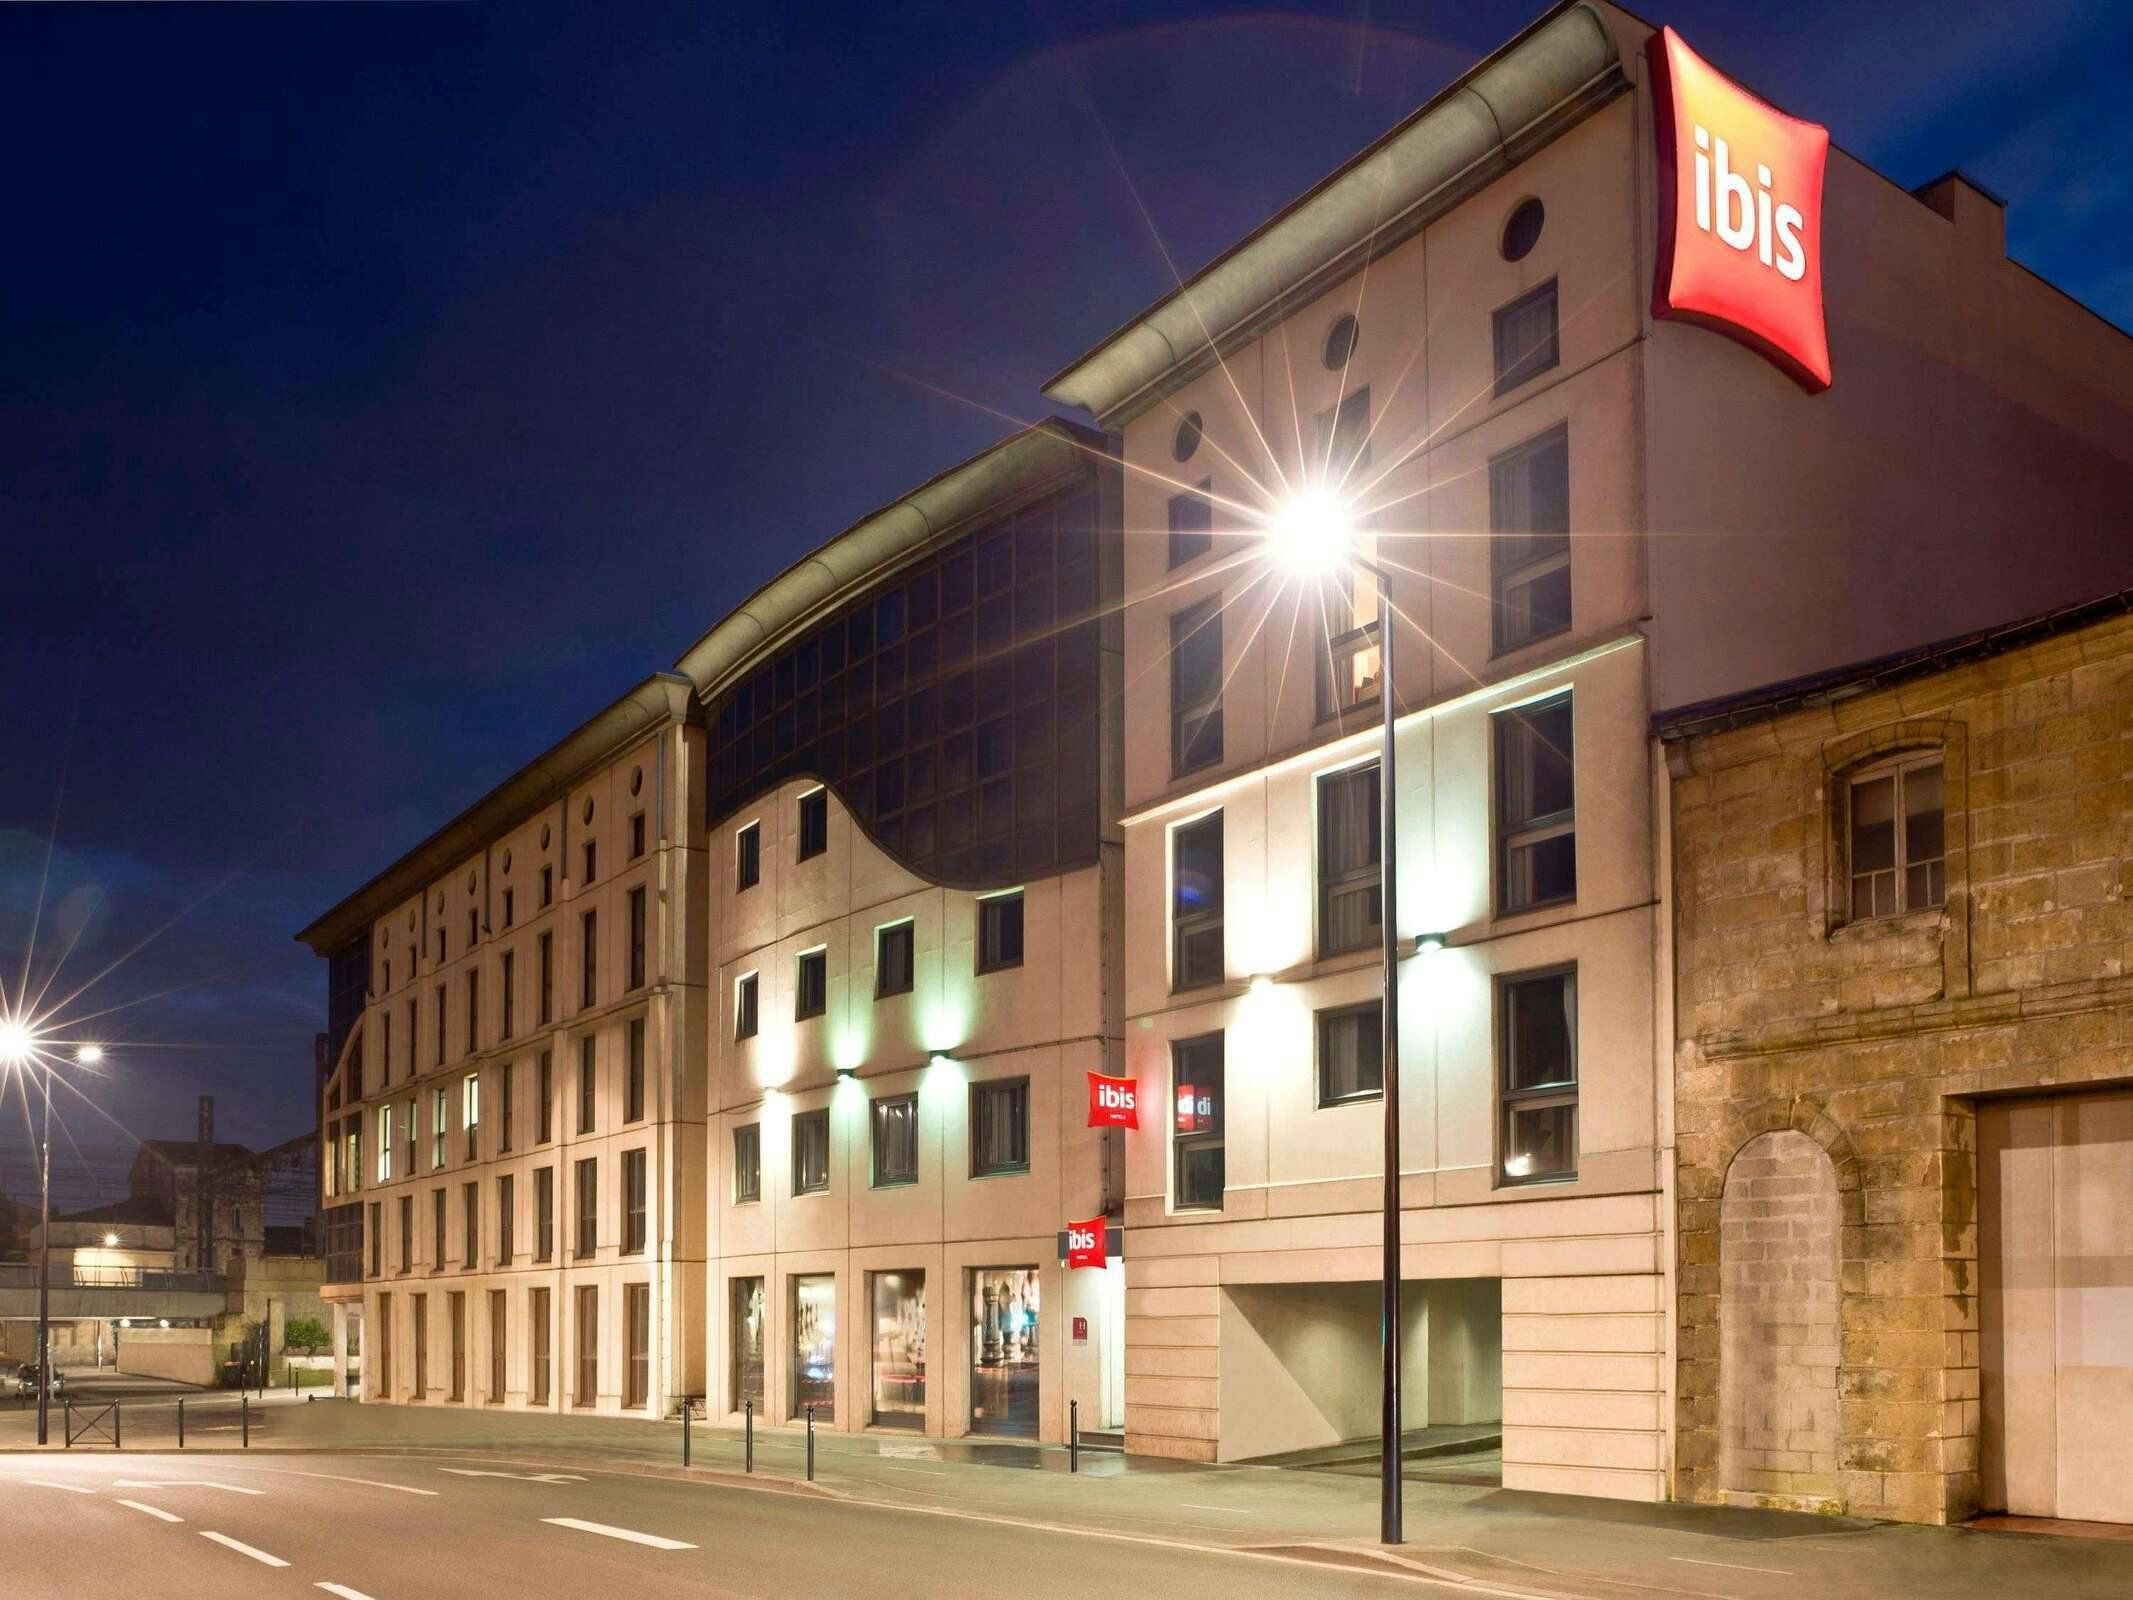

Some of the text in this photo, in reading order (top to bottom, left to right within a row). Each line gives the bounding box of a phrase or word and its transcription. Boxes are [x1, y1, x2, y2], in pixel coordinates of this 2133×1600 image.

[1694, 123, 1806, 281] ibis
[1099, 1084, 1136, 1109] ibis
[1068, 1228, 1096, 1250] ibis
